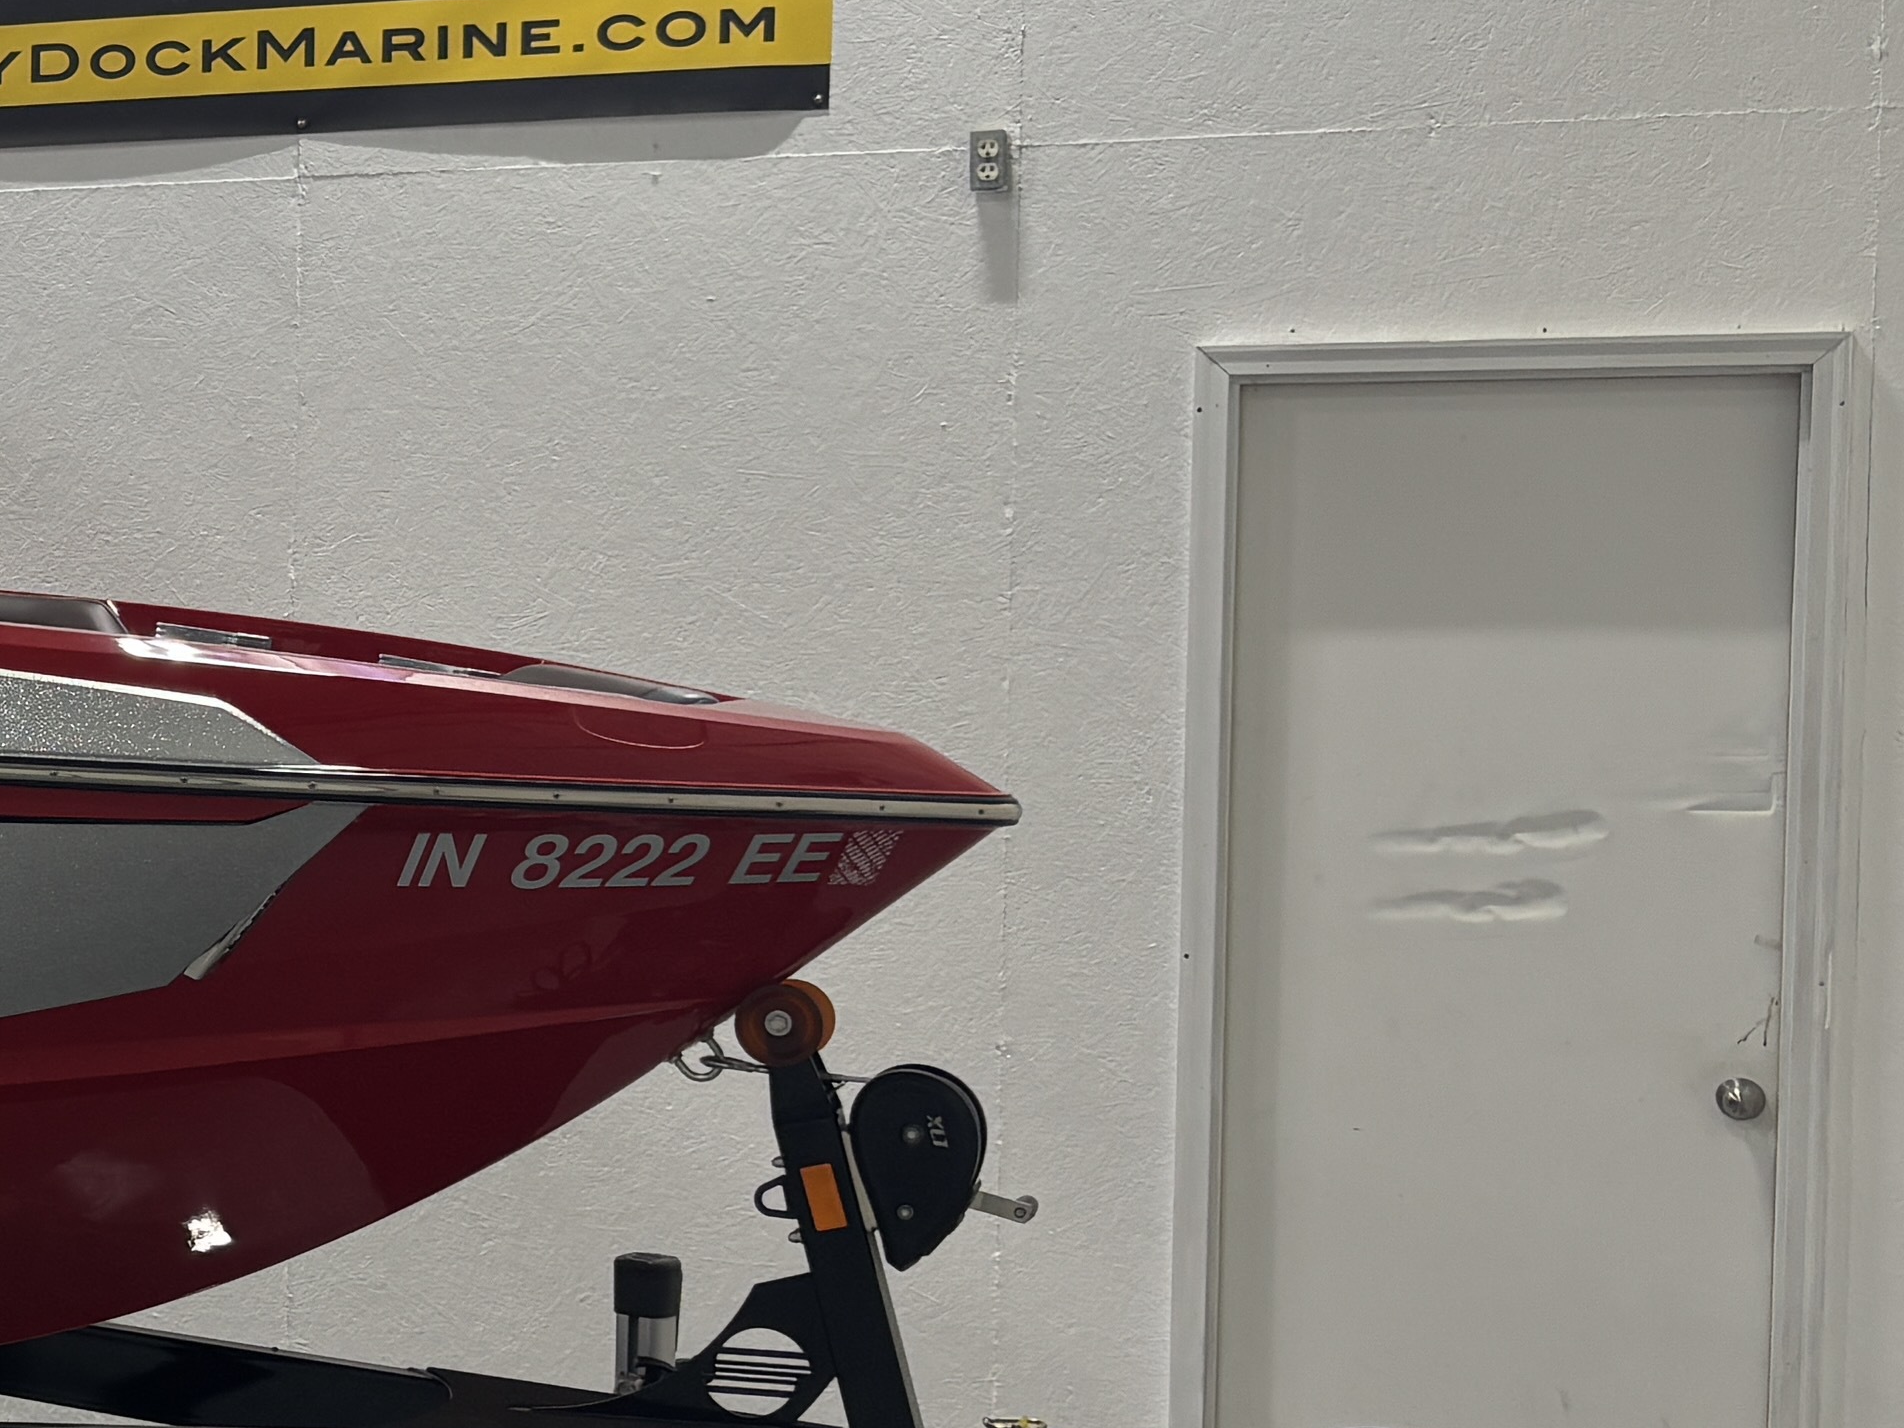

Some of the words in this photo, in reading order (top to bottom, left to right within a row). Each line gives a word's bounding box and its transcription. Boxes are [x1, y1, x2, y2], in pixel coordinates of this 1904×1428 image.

[396, 832, 488, 888] IN
[509, 832, 711, 890] 8222
[728, 832, 845, 886] EE
